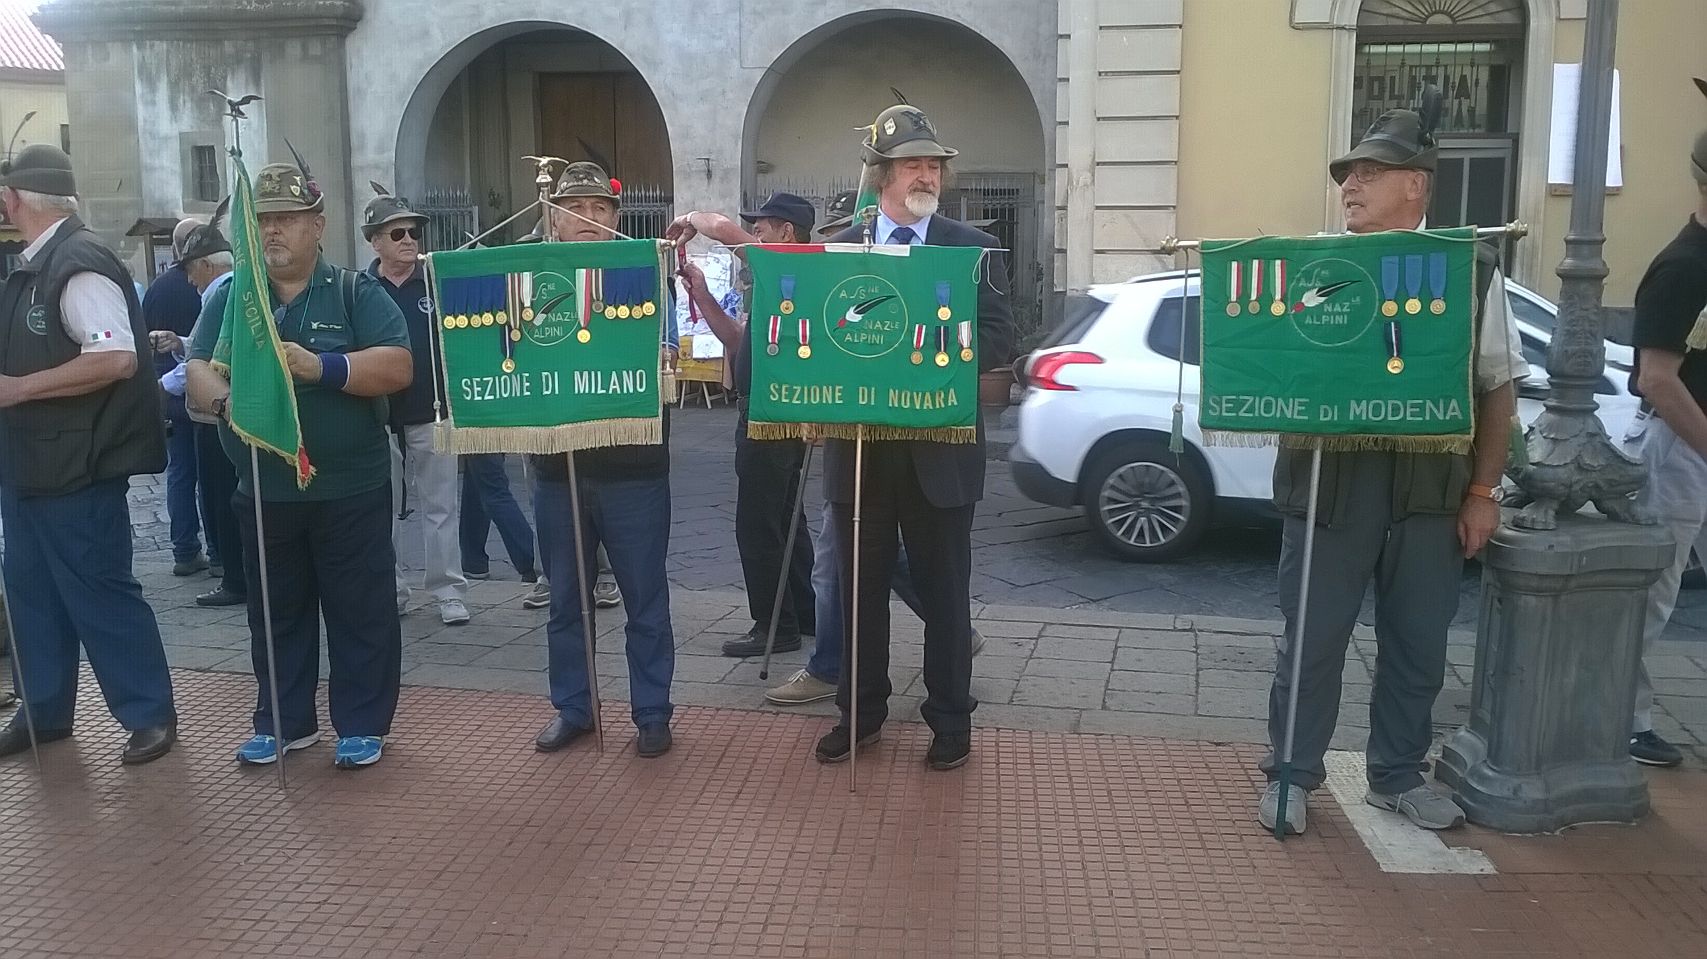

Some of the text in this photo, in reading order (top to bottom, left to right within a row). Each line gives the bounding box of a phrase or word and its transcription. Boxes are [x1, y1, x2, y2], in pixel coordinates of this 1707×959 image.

[242, 291, 267, 351] SICILIA
[534, 326, 563, 338] ALPINI
[1304, 314, 1348, 325] ALPINI
[844, 332, 884, 345] ALPINI
[461, 369, 647, 401] SEZIONE DI MILANO
[769, 382, 958, 411] SEZIONE DI NOVARA
[1208, 395, 1310, 420] SEZIONE
[1350, 398, 1464, 422] MODENA
